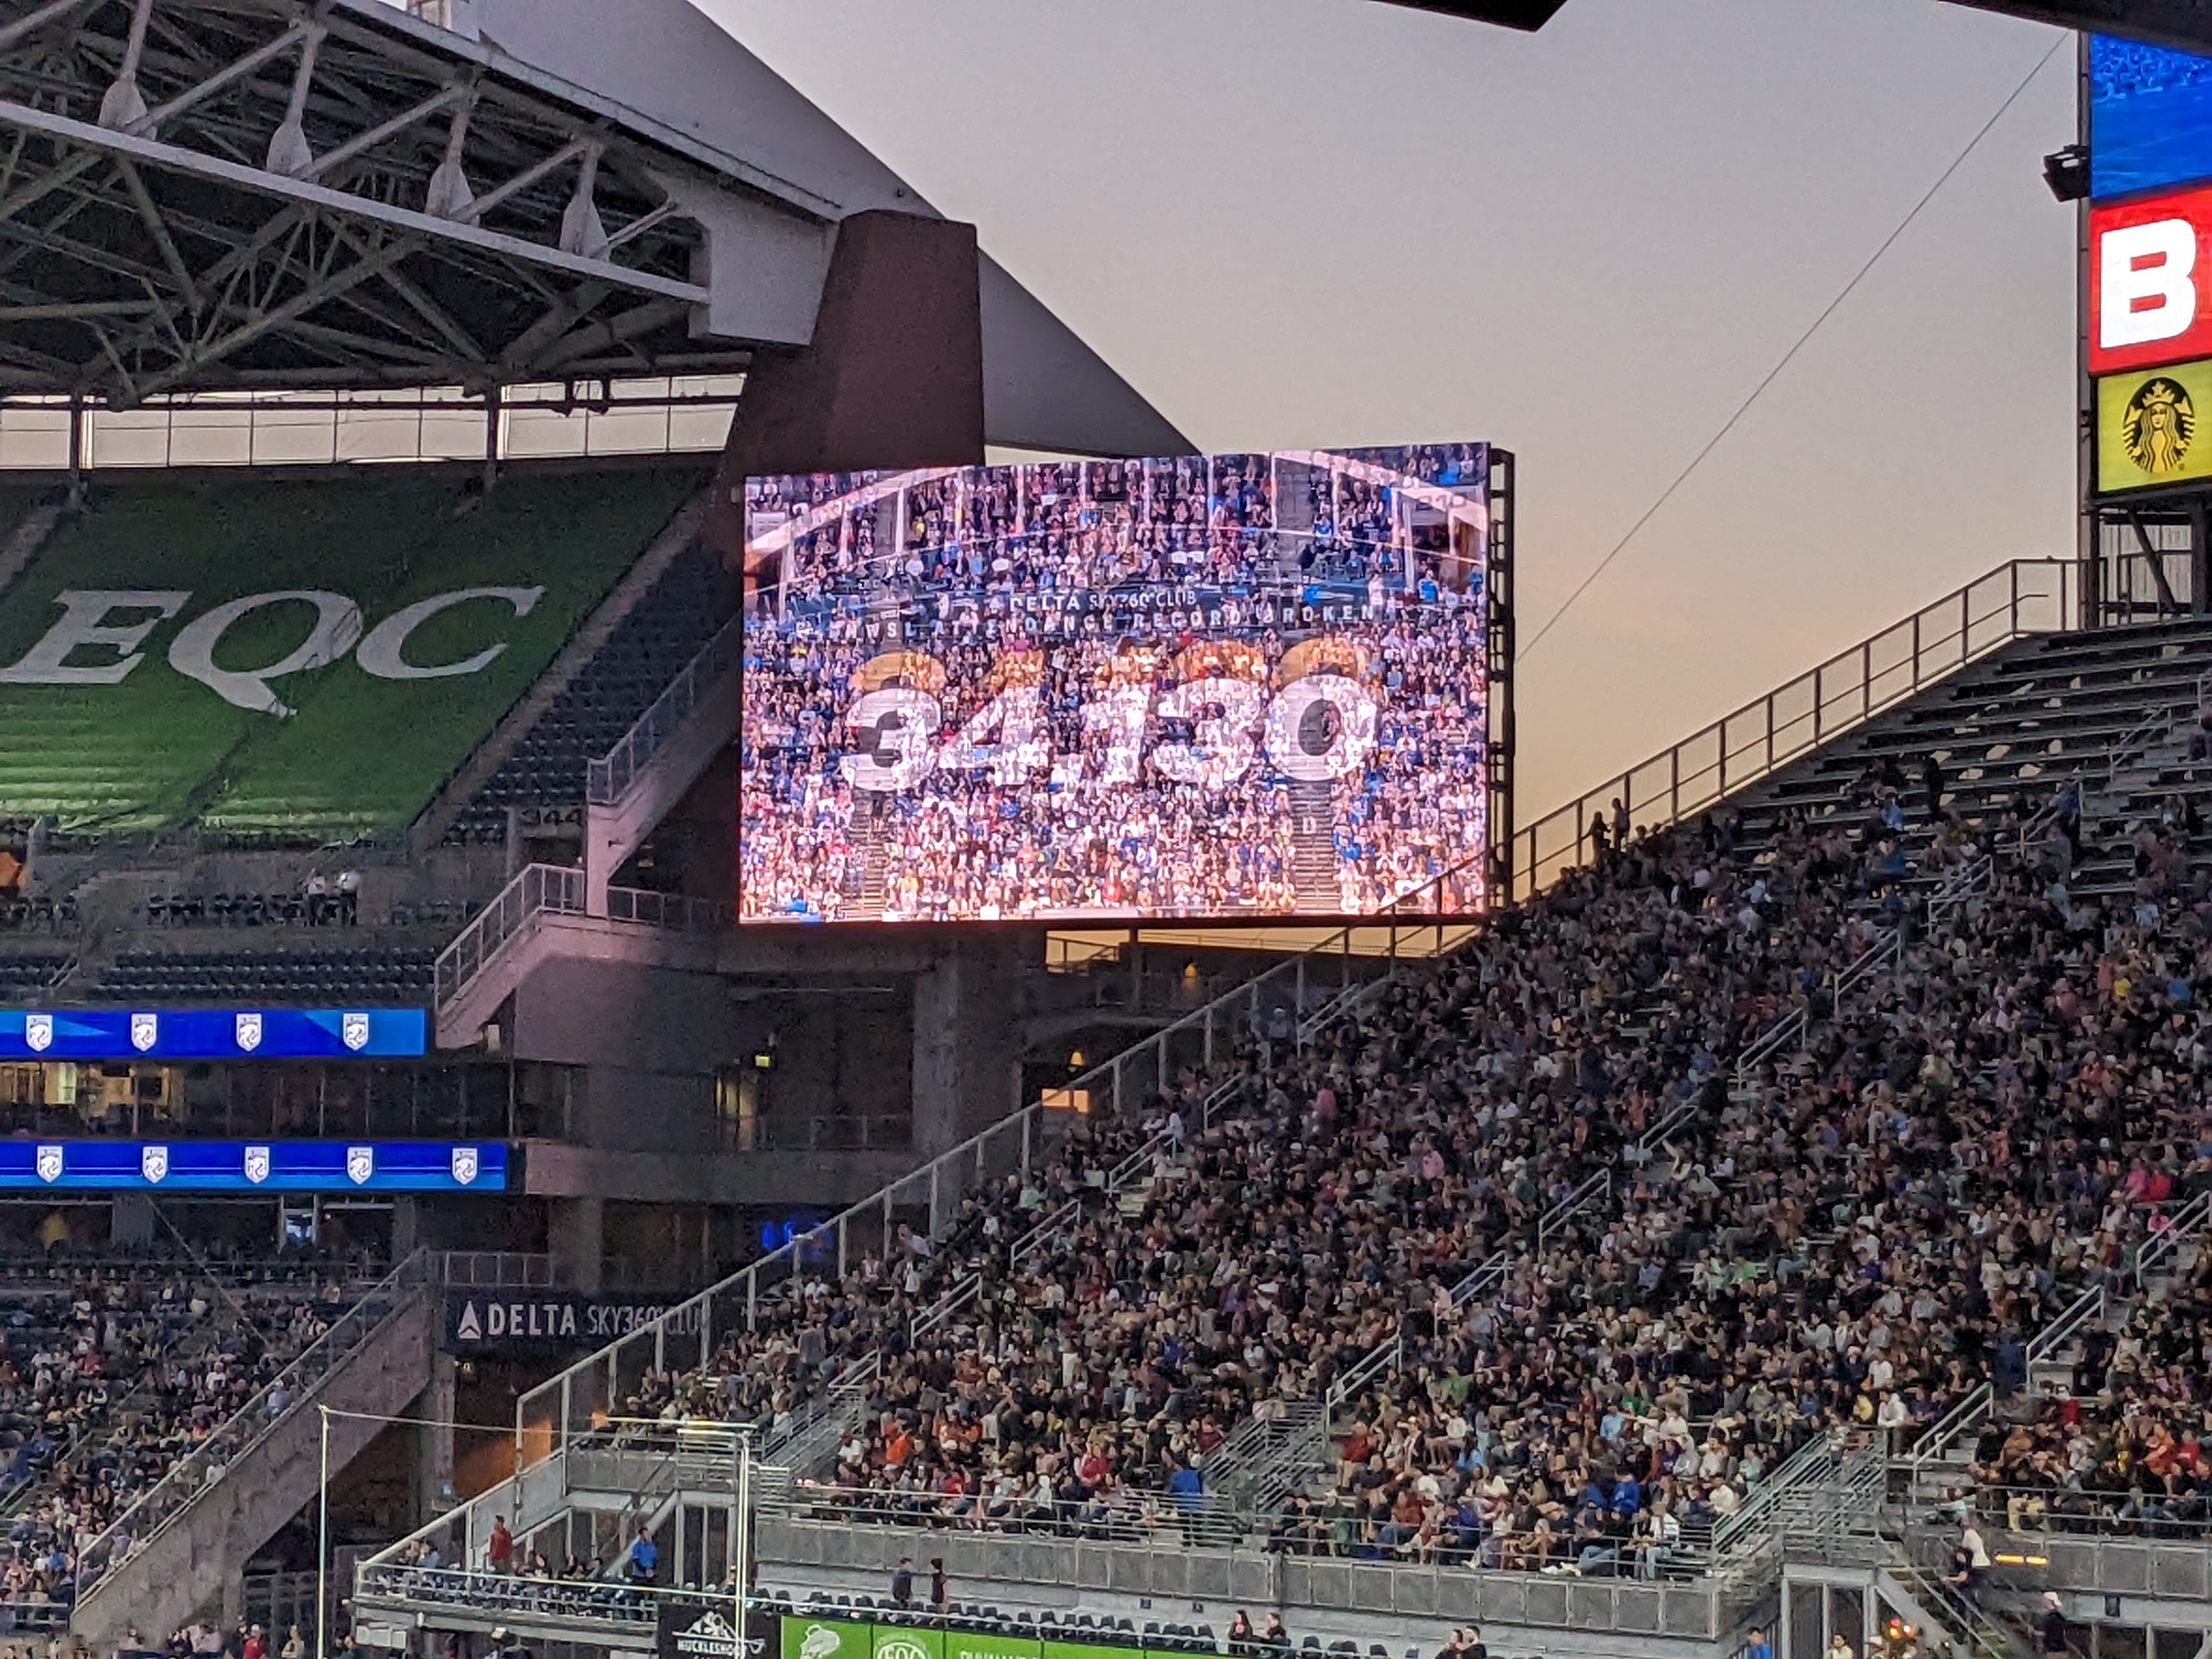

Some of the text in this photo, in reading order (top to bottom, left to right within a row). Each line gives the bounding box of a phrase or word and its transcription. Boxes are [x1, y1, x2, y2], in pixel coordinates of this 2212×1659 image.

[1009, 594, 1081, 612] DELTA
[1156, 590, 1197, 607] CLUB
[1133, 609, 1241, 628] RECORD
[0, 585, 546, 718] EQC
[488, 1302, 575, 1337] DELTA
[665, 1306, 709, 1335] CLU
